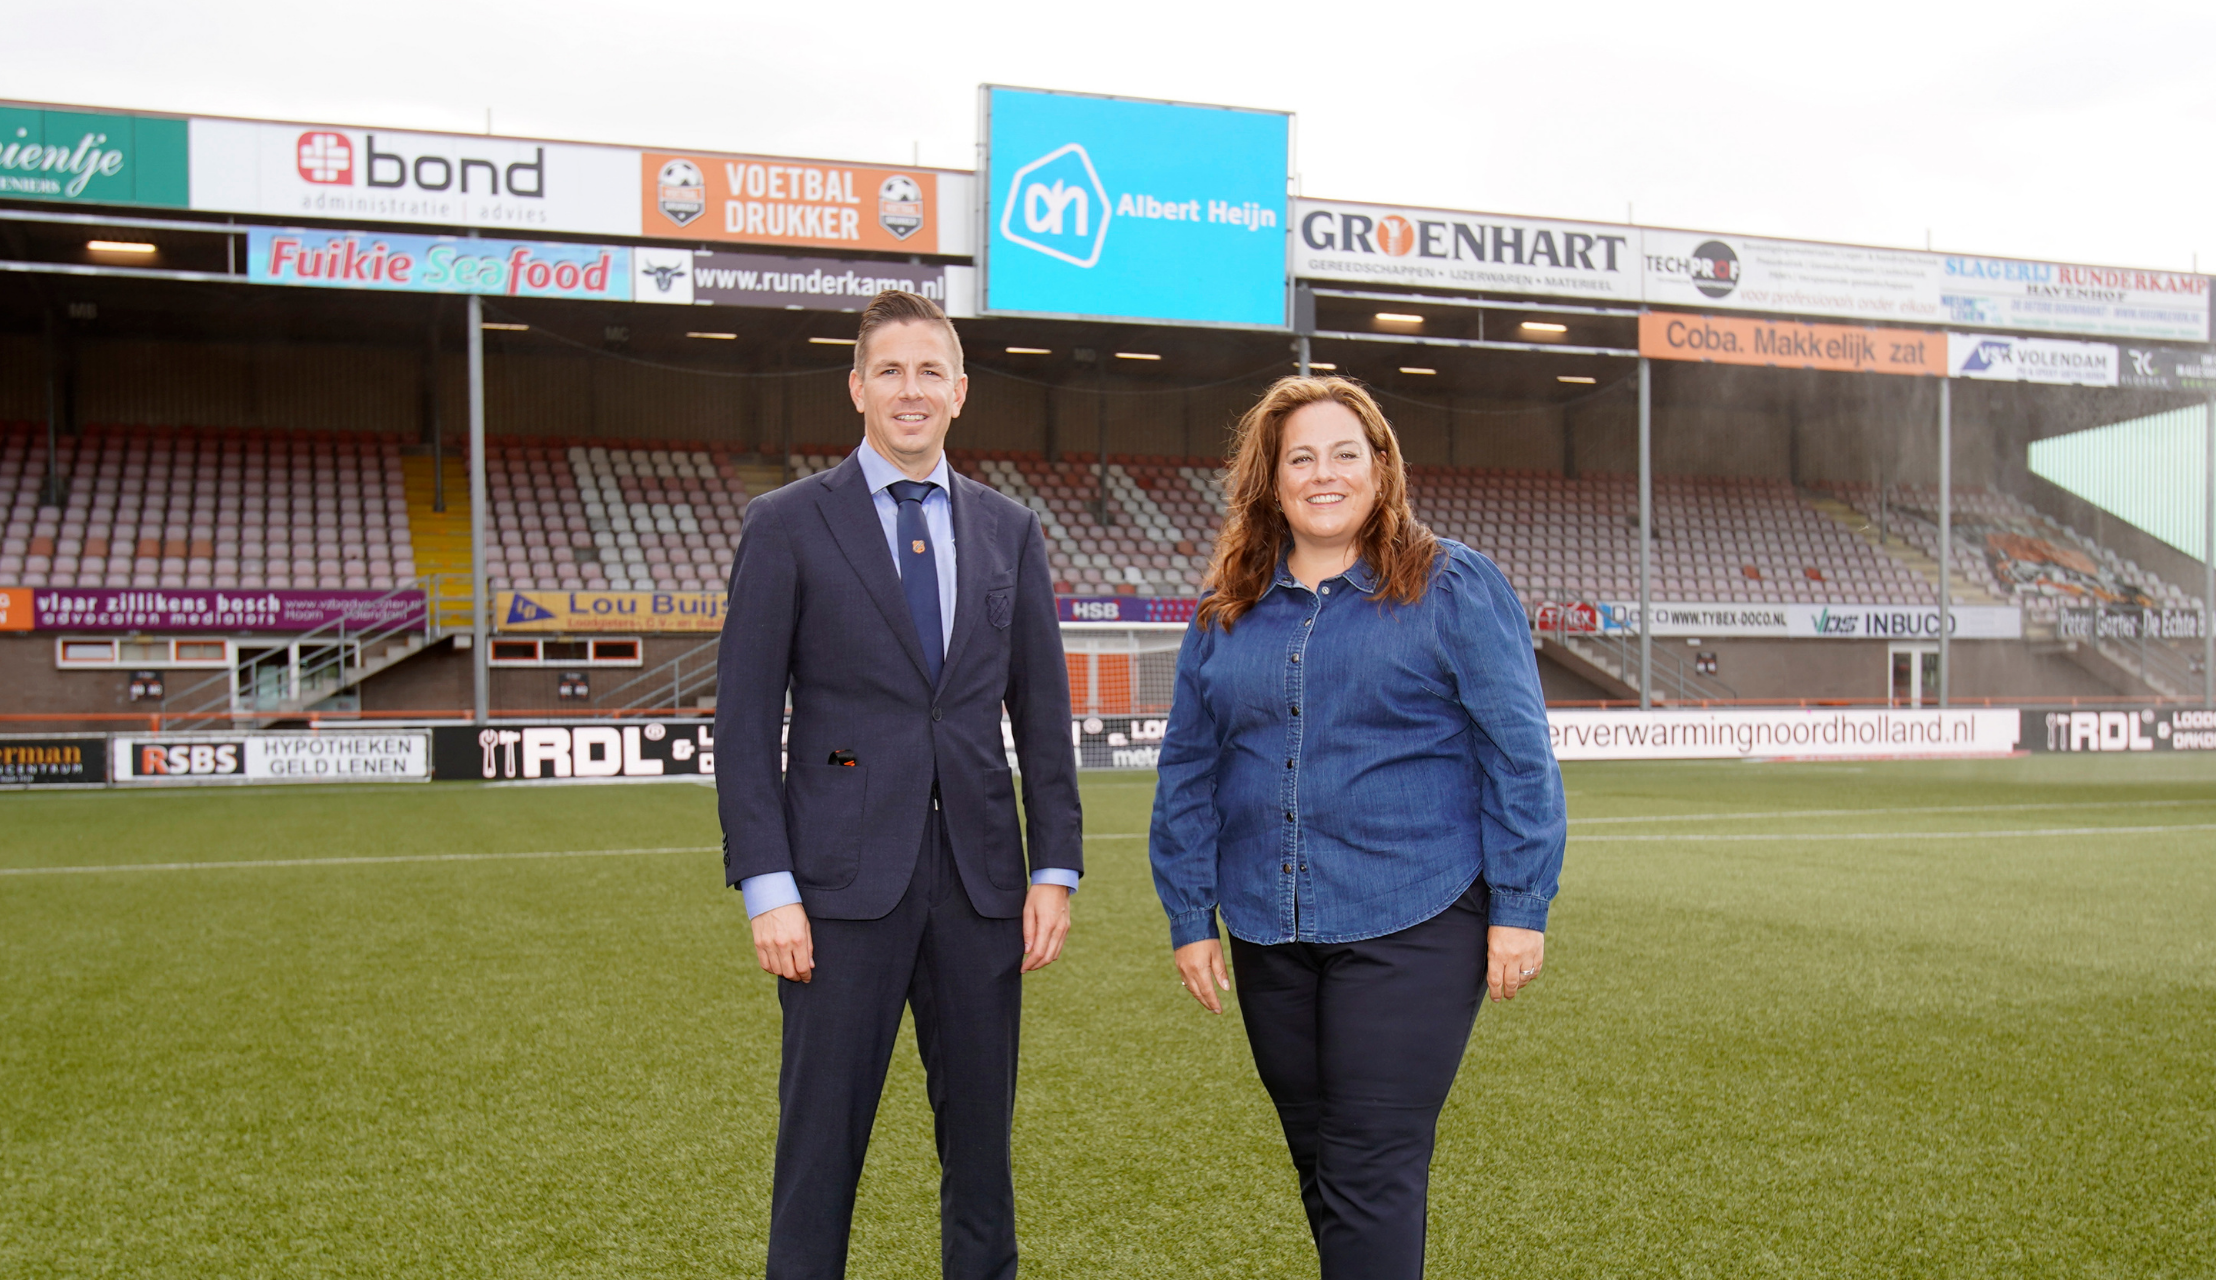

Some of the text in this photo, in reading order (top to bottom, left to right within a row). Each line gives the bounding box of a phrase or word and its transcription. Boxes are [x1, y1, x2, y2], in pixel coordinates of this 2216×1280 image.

[0, 127, 124, 198] ientje
[367, 134, 545, 198] bond
[725, 162, 861, 204] VOETBAL
[303, 191, 548, 223] administratie advies
[725, 200, 861, 240] DRUKKER
[1116, 193, 1277, 232] Albert Heijn
[1301, 210, 1628, 273] GROENHART
[268, 236, 612, 296] Fuikie Seafood
[1309, 259, 1612, 292] GEREEDSCHAPPEN IJZERWAREN MATERIEEL
[1945, 257, 2051, 283] SLAGERIJ
[2058, 264, 2208, 296] RUNDERKAMP
[694, 267, 945, 300] www.runderkamp.nl
[2027, 284, 2127, 302] HAVENHOF
[1667, 320, 1926, 367] Coba. Makkelijk zat
[2016, 349, 2108, 369] VOLENDAM
[37, 592, 281, 613] vlaar zillikens bosch
[284, 609, 325, 622] Hoorn
[569, 592, 637, 614] Lou
[1072, 602, 1120, 619] HSB
[42, 610, 276, 626] advocaten mediators
[1670, 610, 1788, 627] WWW.TYBEX-DOCO.NL
[2143, 609, 2160, 637] De
[2162, 609, 2197, 638] Echte
[2172, 711, 2216, 729] LOOD
[0, 745, 82, 765] rman
[142, 744, 238, 776] RSBS
[264, 738, 412, 756] HYPOTHEKEN
[0, 763, 83, 776] CENTRUM
[270, 757, 407, 775] GELD LENEN
